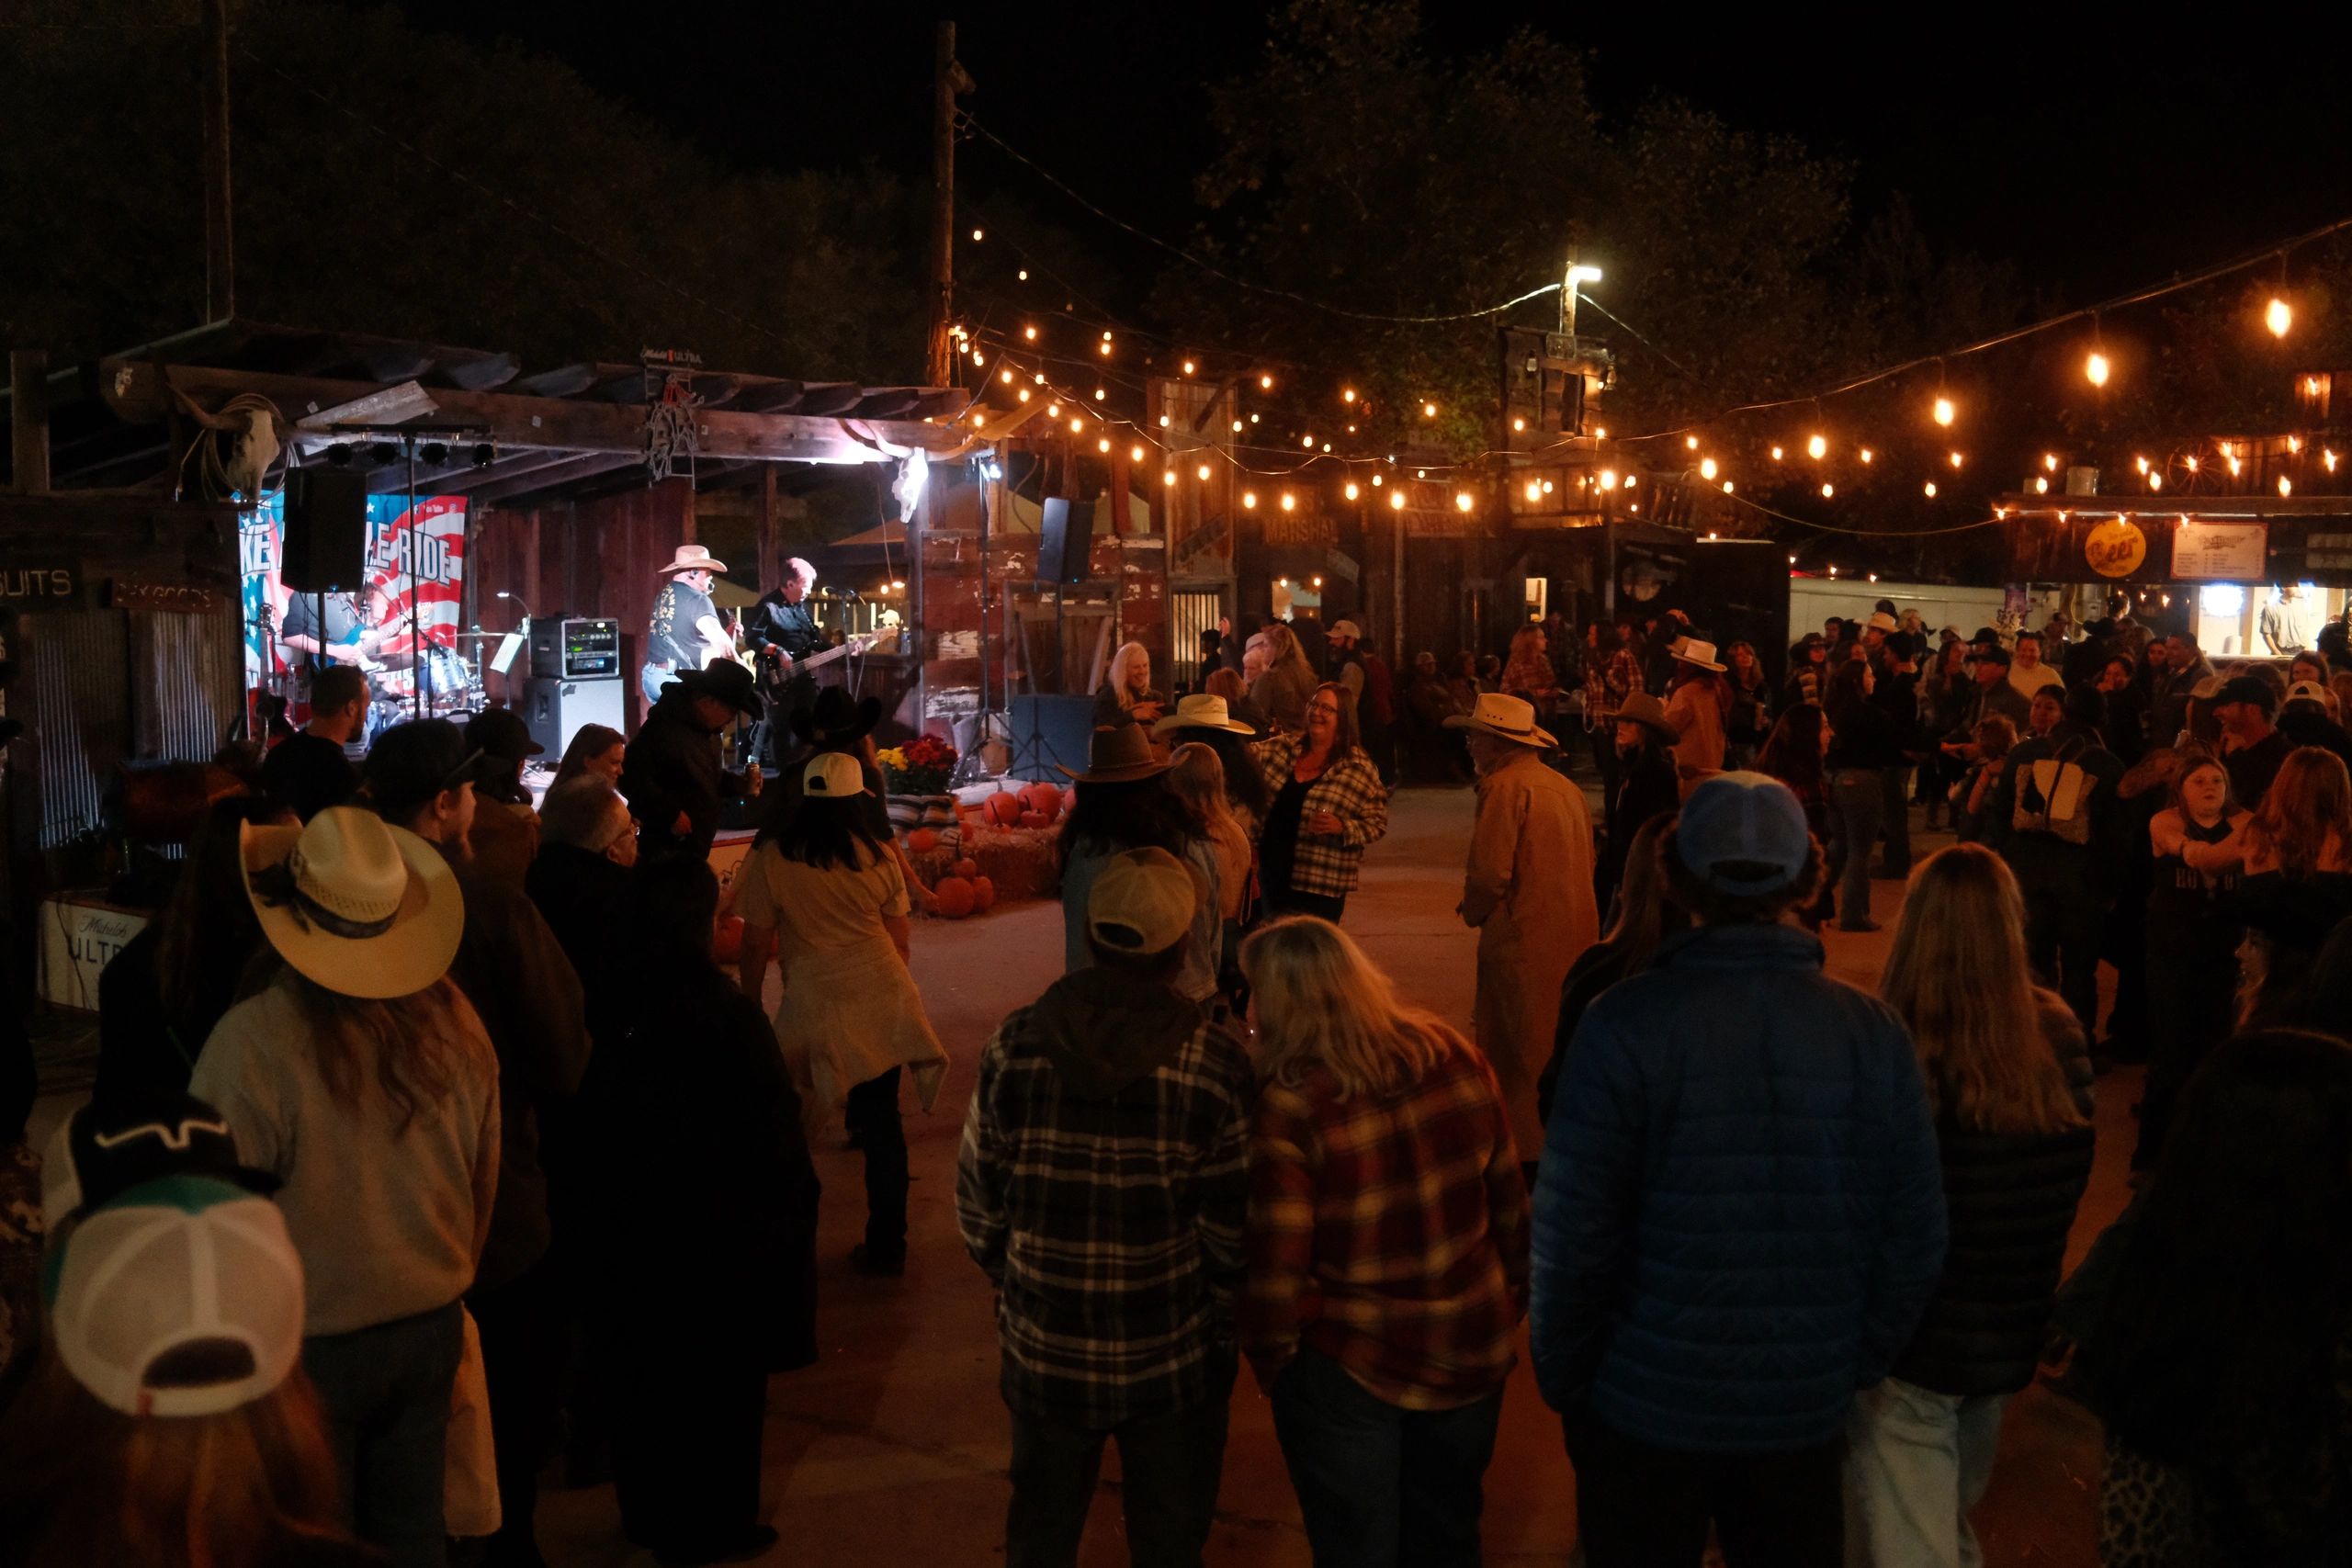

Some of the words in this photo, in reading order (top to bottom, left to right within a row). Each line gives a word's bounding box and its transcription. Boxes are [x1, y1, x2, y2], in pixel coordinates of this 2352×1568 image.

[239, 524, 271, 575] KE
[398, 527, 450, 586] RIDE
[0, 569, 73, 596] UITS
